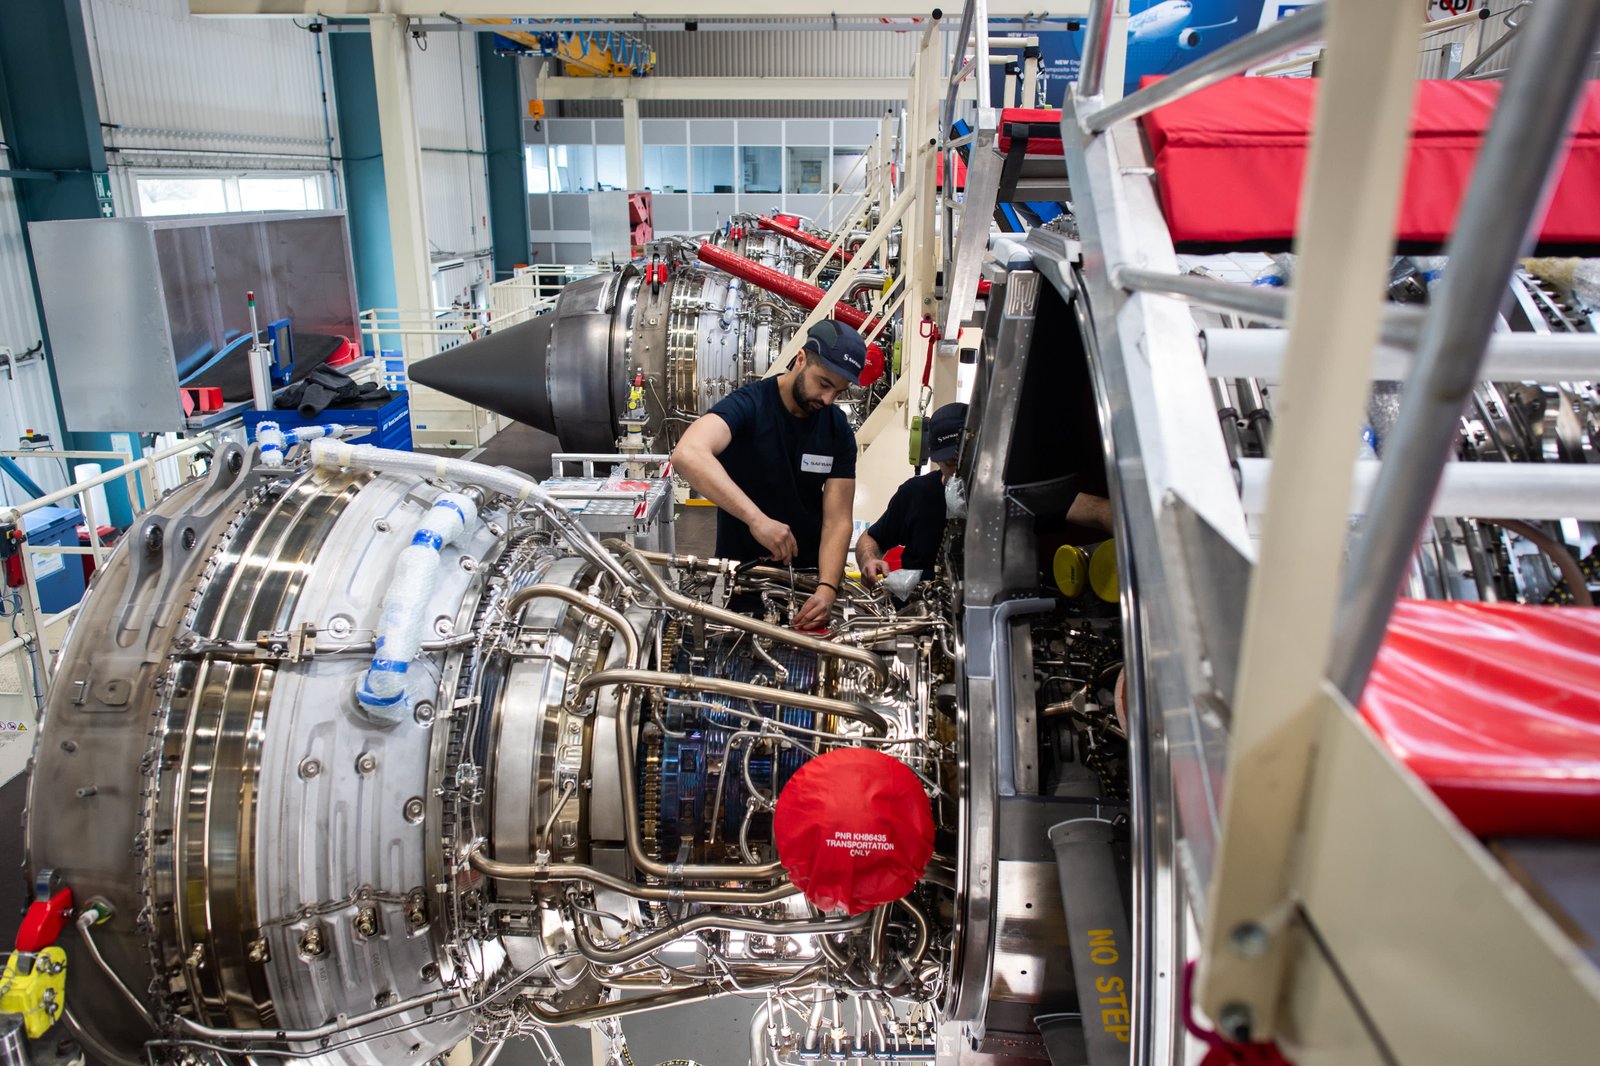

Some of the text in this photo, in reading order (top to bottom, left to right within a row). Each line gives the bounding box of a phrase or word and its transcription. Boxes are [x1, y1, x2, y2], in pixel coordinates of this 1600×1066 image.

[834, 832, 852, 840] PNR
[826, 840, 894, 850] TRANSPORTATION
[850, 848, 870, 857] ONLY
[1088, 929, 1131, 1043] NO STEP
